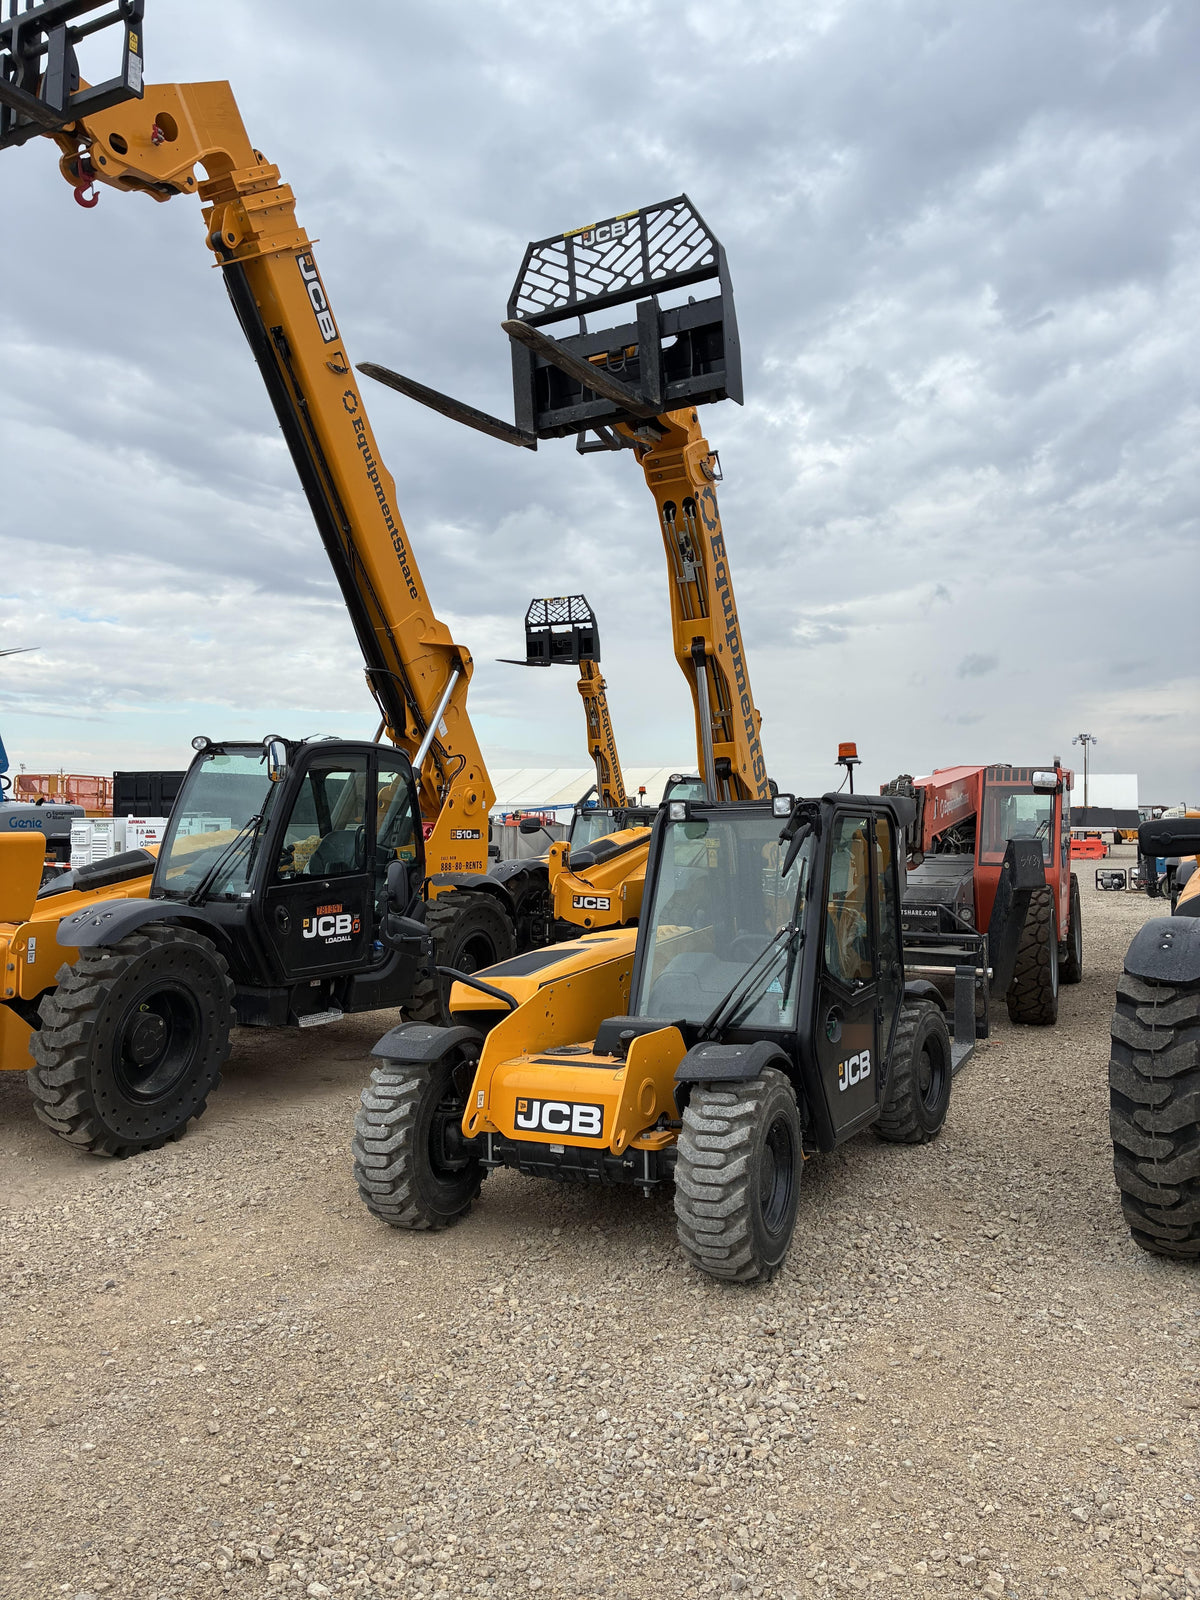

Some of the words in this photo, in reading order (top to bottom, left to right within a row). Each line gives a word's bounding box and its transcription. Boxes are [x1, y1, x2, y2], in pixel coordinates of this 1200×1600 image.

[583, 221, 626, 246] JCB
[298, 257, 337, 341] JCB
[352, 416, 418, 600] EquipmentShare
[9, 817, 42, 828] Genie
[441, 861, 482, 871] 888-80-RENTS
[573, 896, 609, 910] JCB
[303, 914, 352, 938] JCB
[325, 936, 351, 944] LOADALL
[838, 1050, 870, 1091] JCB
[517, 1101, 601, 1135] JCB
